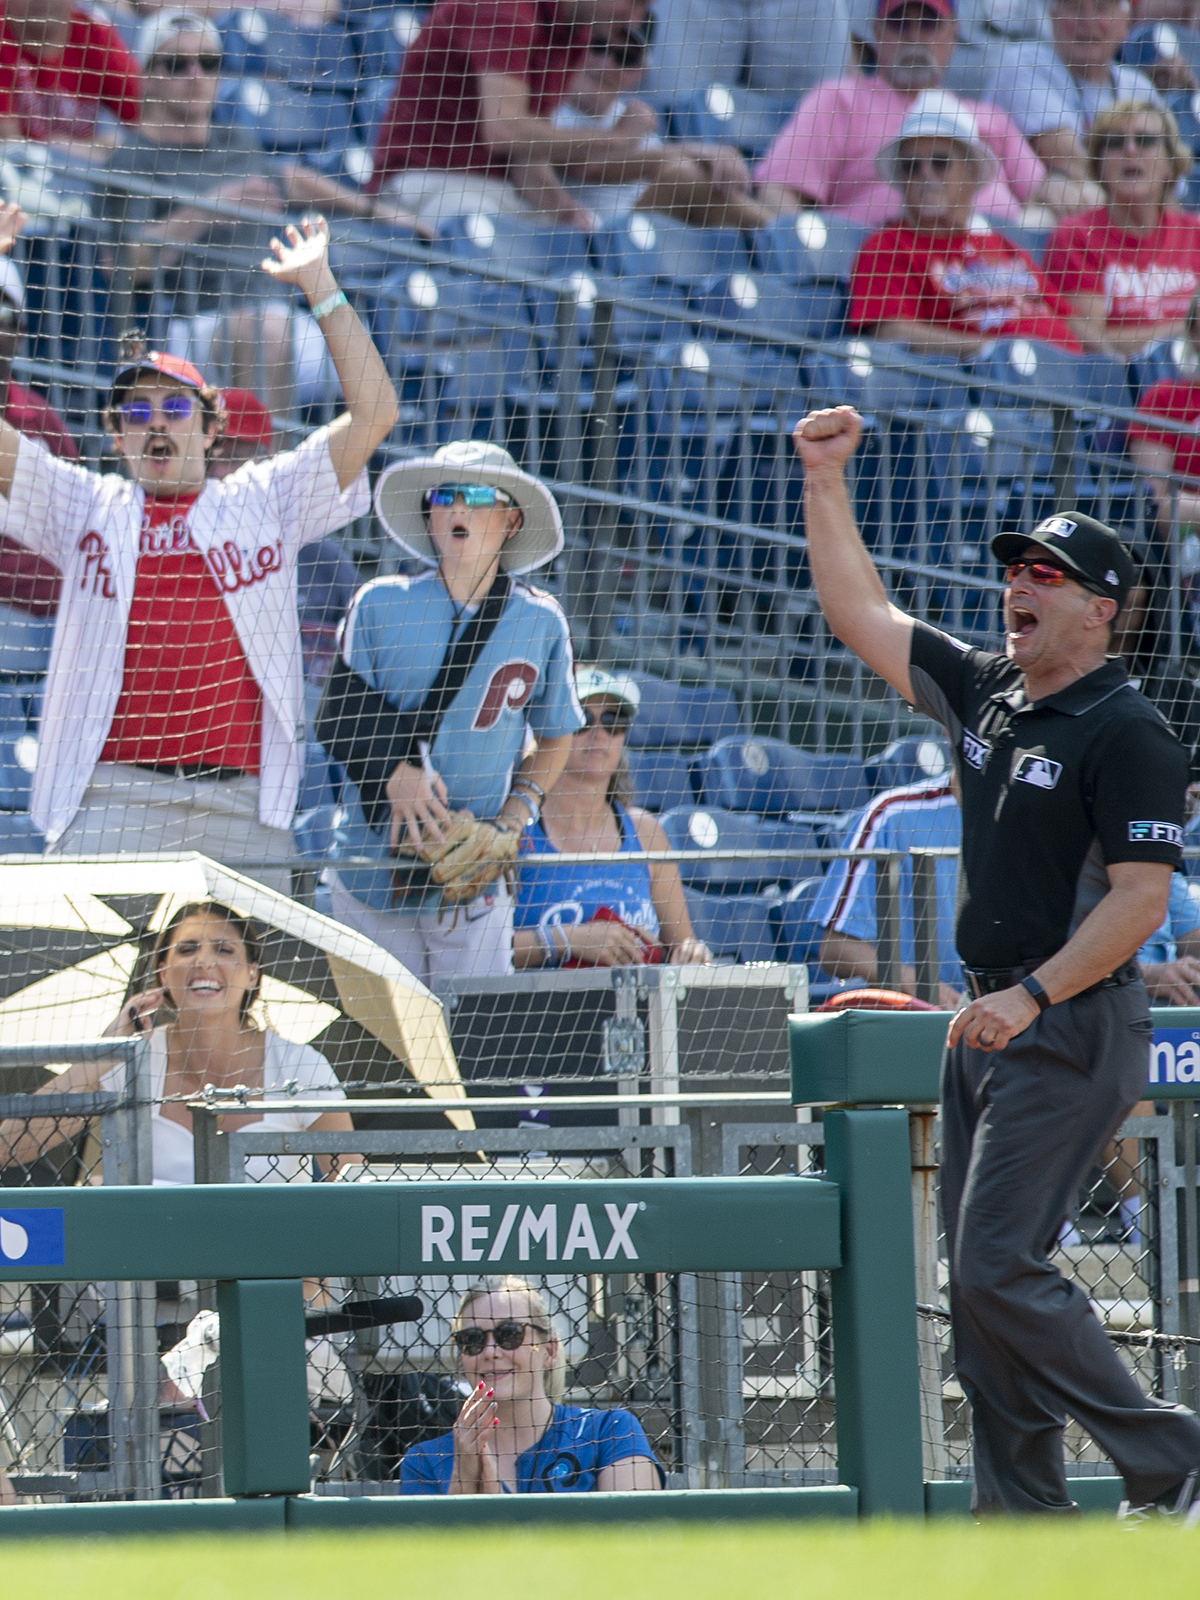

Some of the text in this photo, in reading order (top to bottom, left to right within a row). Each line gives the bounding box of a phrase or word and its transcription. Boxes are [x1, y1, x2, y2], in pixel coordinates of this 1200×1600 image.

[470, 658, 539, 731] P
[962, 734, 988, 766] FTX
[421, 1203, 640, 1262] RE/MAX
